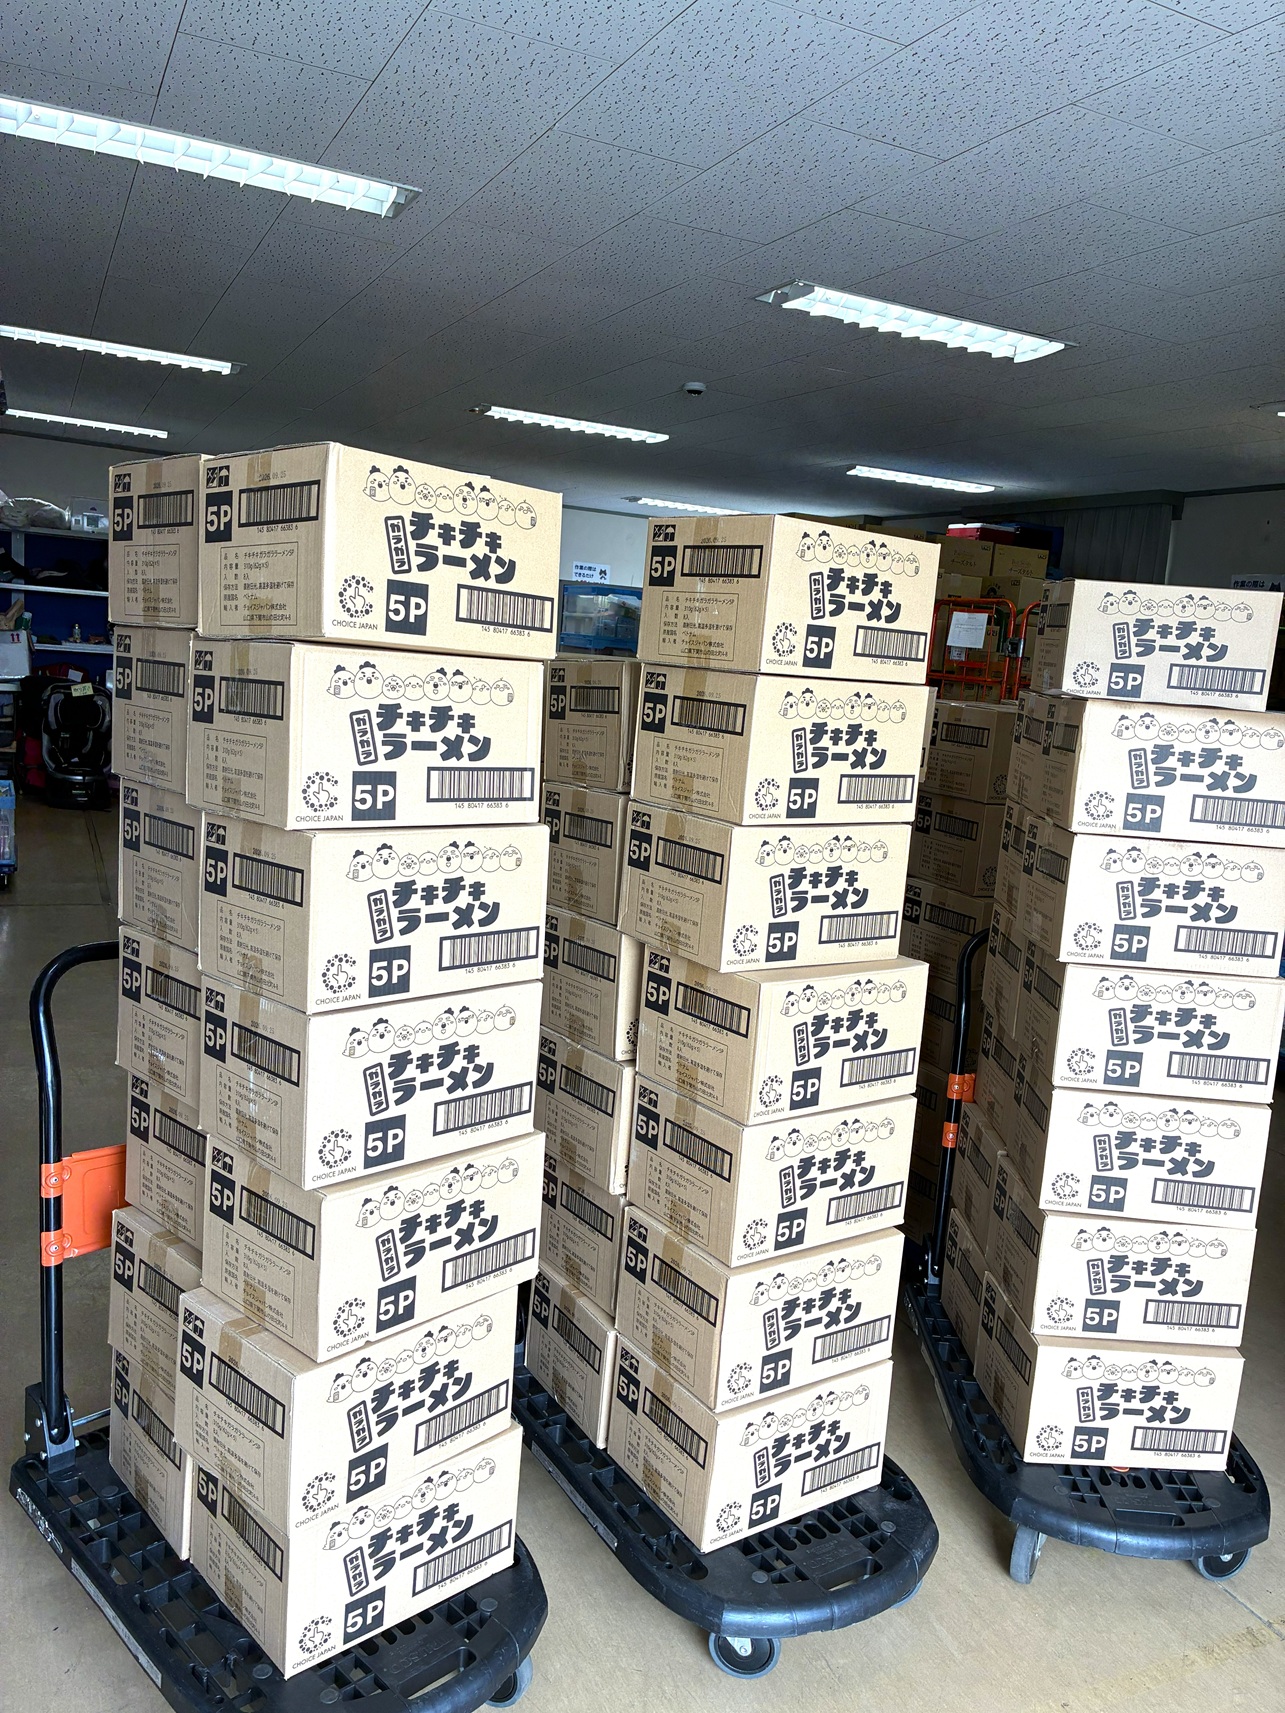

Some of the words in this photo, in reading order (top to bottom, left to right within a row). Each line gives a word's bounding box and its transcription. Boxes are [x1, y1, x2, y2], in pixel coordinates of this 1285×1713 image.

[115, 508, 132, 531] 5P
[207, 505, 231, 531] 5P
[409, 511, 501, 555] チキチキ
[414, 542, 516, 584] ラーメン
[650, 556, 675, 577] 5P
[826, 567, 892, 599] チキチキ
[388, 594, 426, 623] 5P
[828, 593, 901, 624] ラーメン
[332, 619, 357, 629] CHOICE
[358, 622, 378, 630] JAPAN
[1132, 618, 1216, 642] チキチキ
[805, 636, 833, 659] 5P
[1135, 638, 1228, 662] ラーメン
[766, 658, 783, 666] CHOICE
[116, 667, 132, 690] 5P
[1110, 672, 1142, 690] 5P
[194, 687, 214, 712] 5P
[550, 694, 566, 712] 5P
[643, 702, 666, 723] 5P
[376, 703, 475, 734] チキチキ
[809, 721, 878, 747] チキチキ
[381, 733, 491, 762] ラーメン
[811, 746, 887, 770] ラーメン
[1150, 744, 1243, 771] チキチキ
[1153, 766, 1257, 794] ラーメン
[354, 785, 394, 810] 5P
[788, 789, 817, 809] 5P
[295, 815, 321, 823] CHOICE
[1126, 803, 1162, 823] 5P
[124, 818, 140, 842] 5P
[629, 839, 650, 861] 5P
[205, 858, 227, 884] 5P
[787, 866, 858, 890] チキチキ
[392, 877, 485, 909] チキチキ
[790, 887, 869, 913] ラーメン
[1137, 876, 1225, 903] チキチキ
[397, 901, 500, 936] ラーメン
[1140, 898, 1238, 924] ラーメン
[768, 932, 797, 953] 5P
[1113, 933, 1147, 953] 5P
[123, 967, 141, 992] 5P
[371, 959, 409, 986] 5P
[315, 996, 340, 1006] CHOICE
[341, 993, 361, 1002] JAPAN
[647, 981, 669, 1005] 5P
[811, 1009, 878, 1038] チキチキ
[1129, 1004, 1217, 1030] チキチキ
[205, 1022, 226, 1050] 5P
[813, 1028, 888, 1060] ラーメン
[1132, 1024, 1230, 1051] ラーメン
[388, 1042, 480, 1080] チキチキ
[538, 1062, 555, 1084] 5P
[1106, 1059, 1140, 1078] 5P
[392, 1062, 494, 1106] ラーメン
[792, 1078, 819, 1101] 5P
[131, 1106, 149, 1132] 5P
[637, 1113, 658, 1138] 5P
[752, 1109, 770, 1117] CHOICE
[366, 1128, 403, 1157] 5P
[1114, 1130, 1202, 1157] チキチキ
[796, 1148, 866, 1180] チキチキ
[1117, 1151, 1215, 1178] ラーメン
[210, 1181, 234, 1211] 5P
[799, 1165, 875, 1201] ラーメン
[1091, 1184, 1125, 1203] 5P
[398, 1199, 485, 1245] チキチキ
[777, 1218, 805, 1241] 5P
[403, 1214, 498, 1269] ラーメン
[115, 1252, 134, 1280] 5P
[626, 1245, 647, 1272] 5P
[1107, 1254, 1191, 1278] チキチキ
[1110, 1274, 1204, 1298] ラーメン
[379, 1290, 414, 1321] 5P
[533, 1293, 549, 1318] 5P
[781, 1287, 852, 1322] チキチキ
[1085, 1307, 1117, 1325] 5P
[783, 1302, 862, 1342] ラーメン
[327, 1339, 350, 1353] CHOICE
[351, 1331, 370, 1344] JAPAN
[179, 1343, 202, 1375] 5P
[761, 1359, 790, 1383] 5P
[115, 1378, 129, 1407] 5P
[370, 1359, 458, 1414] チキチキ
[618, 1374, 638, 1402] 5P
[1096, 1382, 1179, 1405] チキチキ
[375, 1372, 472, 1437] ラーメン
[1099, 1402, 1191, 1425] ラーメン
[771, 1420, 841, 1459] チキチキ
[1073, 1435, 1106, 1452] 5P
[773, 1432, 851, 1478] ラーメン
[197, 1471, 216, 1503] 5P
[350, 1457, 386, 1492] 5P
[751, 1494, 779, 1519] 5P
[367, 1502, 459, 1559] チキチキ
[372, 1514, 474, 1581] ラーメン
[346, 1600, 383, 1635] 5P
